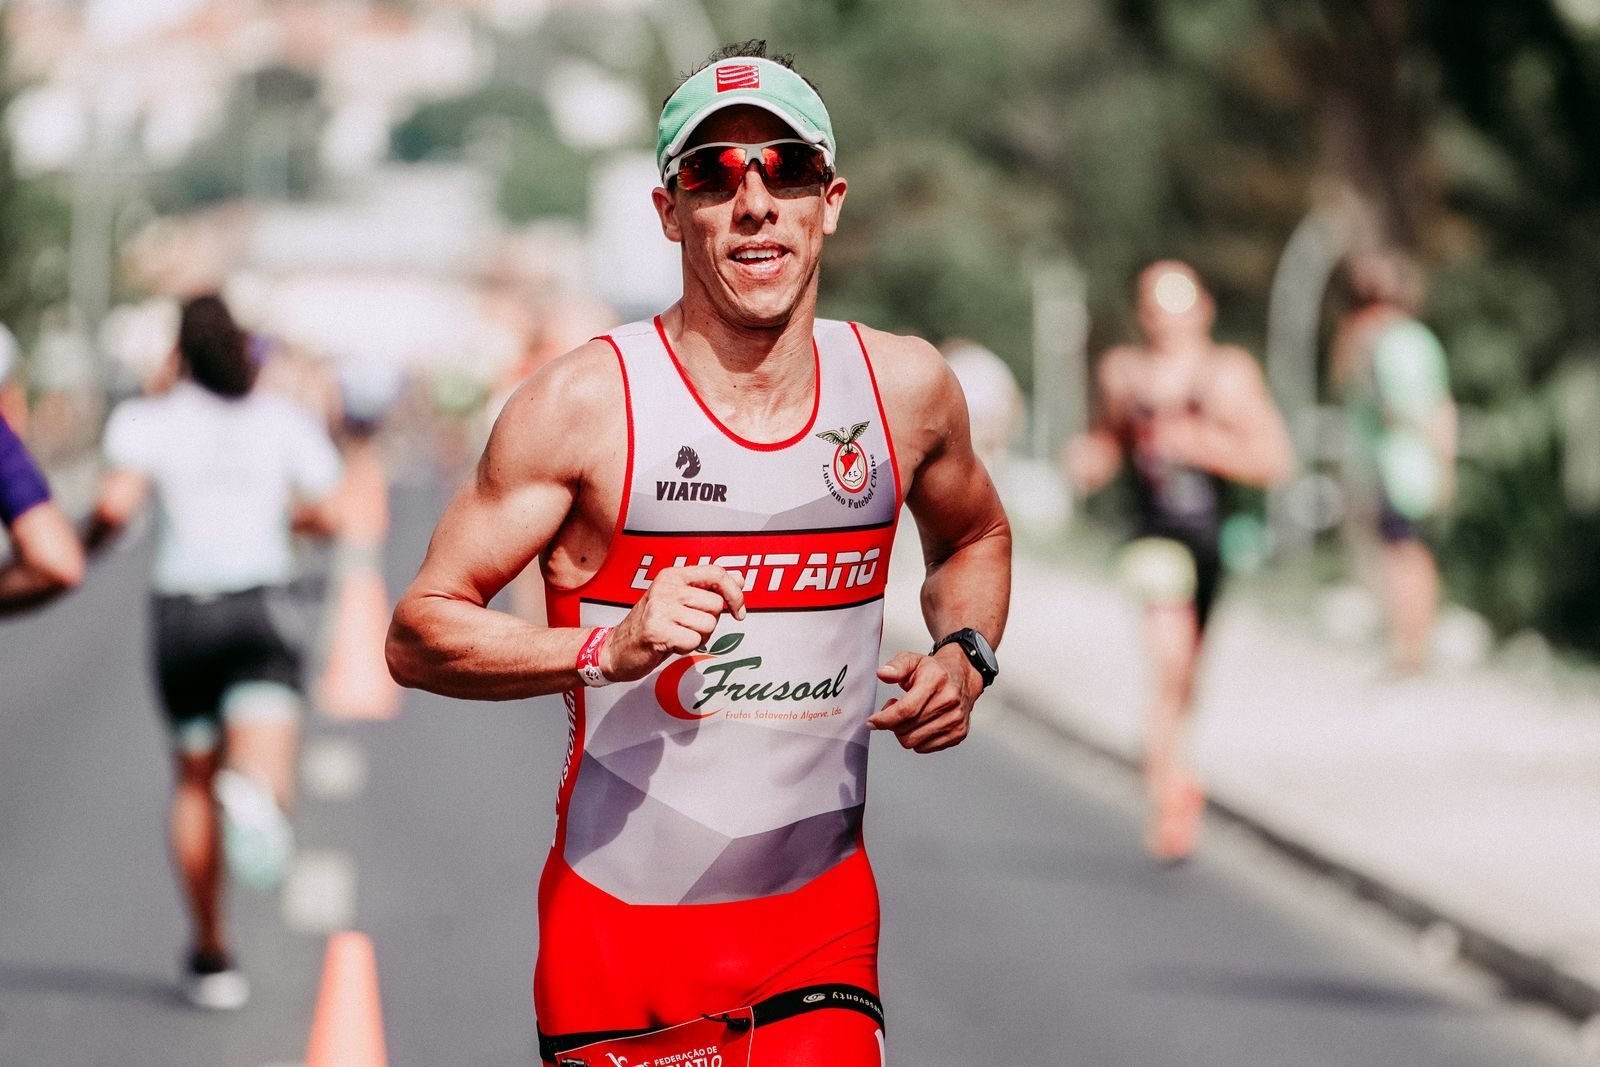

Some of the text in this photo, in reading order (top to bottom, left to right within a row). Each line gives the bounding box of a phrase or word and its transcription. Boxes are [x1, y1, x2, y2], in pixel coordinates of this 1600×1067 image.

[656, 481, 727, 502] VIATOR
[822, 463, 846, 505] Lusitano
[848, 488, 874, 509] Futebol
[630, 548, 880, 592] LSITANO
[693, 656, 848, 709] Frusoal
[654, 1046, 718, 1066] FEDERAÇÃO DE
